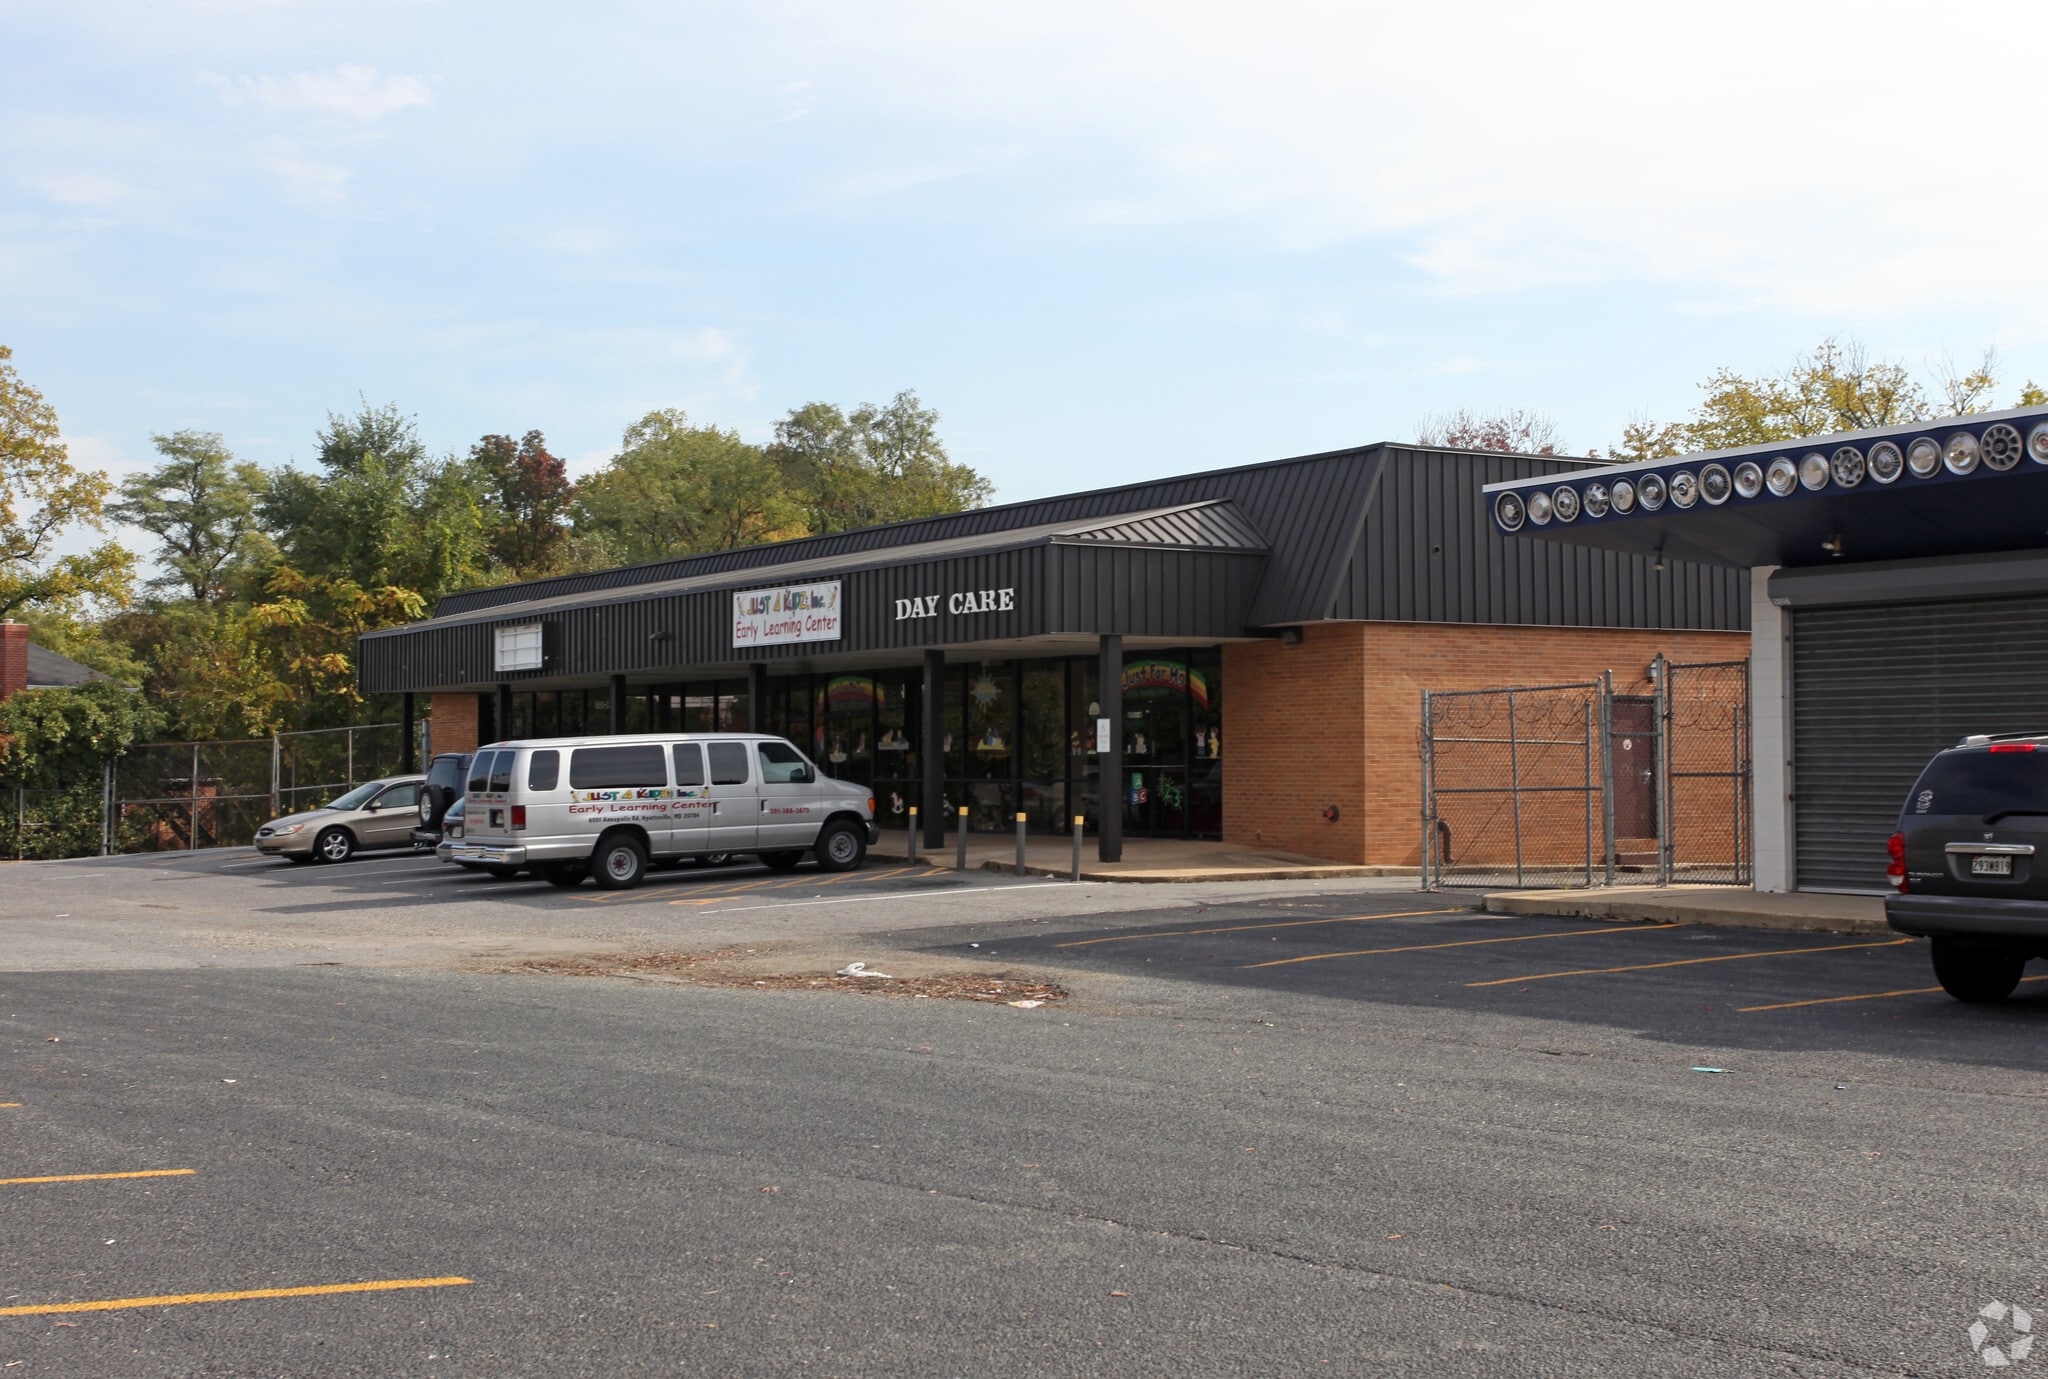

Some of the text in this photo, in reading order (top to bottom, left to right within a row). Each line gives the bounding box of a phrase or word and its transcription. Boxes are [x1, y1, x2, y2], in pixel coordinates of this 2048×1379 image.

[747, 595, 771, 615] JUST
[773, 592, 781, 612] 4
[895, 588, 1014, 620] DAY CARE
[736, 615, 837, 642] Early Learning Center
[583, 791, 620, 801] JUST
[622, 789, 633, 799] 4
[568, 801, 713, 814] Early Learning Center
